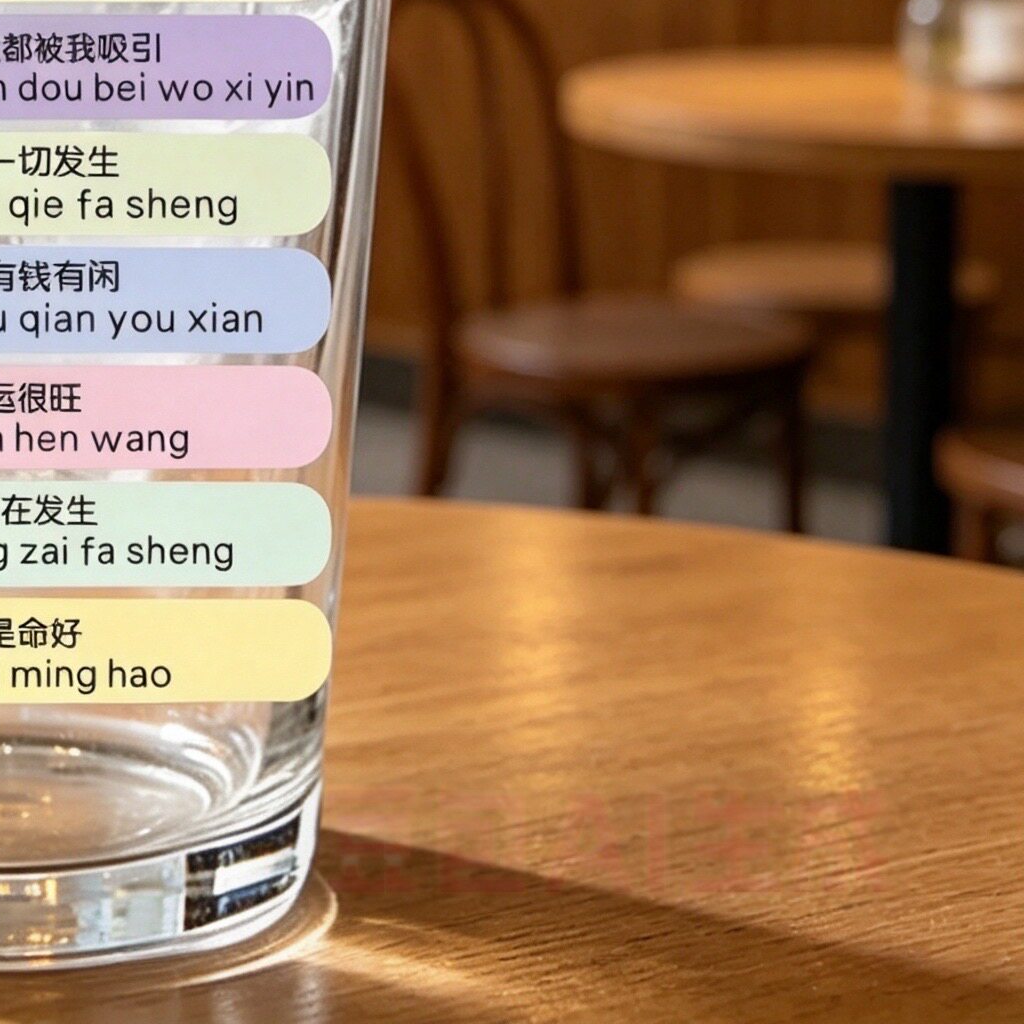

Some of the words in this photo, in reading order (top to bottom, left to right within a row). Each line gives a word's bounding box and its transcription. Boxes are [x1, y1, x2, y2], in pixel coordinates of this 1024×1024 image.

[17, 71, 83, 102] dou
[94, 71, 146, 103] bei
[157, 79, 214, 103] wo
[224, 71, 253, 103] xi
[264, 71, 315, 109] yin
[8, 187, 64, 227] qie
[76, 188, 114, 221] fa
[126, 187, 238, 226] sheng
[19, 301, 95, 339] qian
[107, 309, 175, 341] you
[187, 301, 263, 334] xian
[15, 421, 78, 453] hen
[90, 429, 189, 460] wang
[20, 535, 68, 565] zai
[80, 536, 115, 566] fa
[126, 534, 233, 572] sheng
[11, 658, 97, 695] ming
[108, 658, 172, 689] hao
